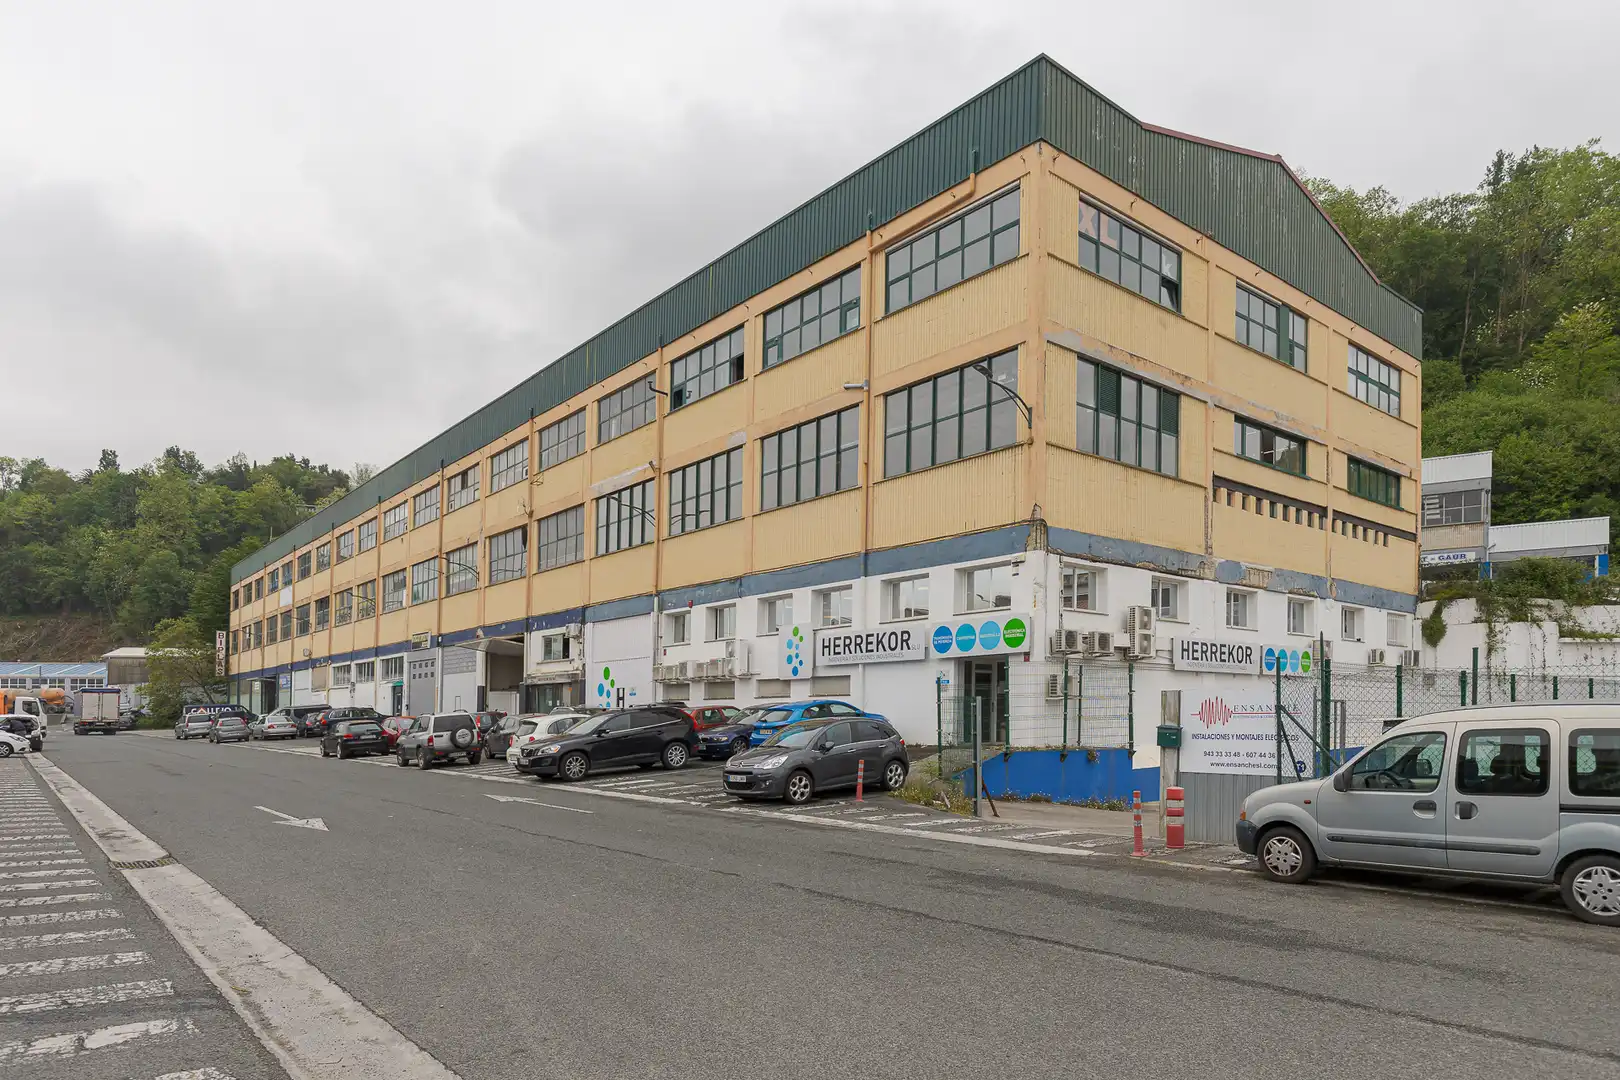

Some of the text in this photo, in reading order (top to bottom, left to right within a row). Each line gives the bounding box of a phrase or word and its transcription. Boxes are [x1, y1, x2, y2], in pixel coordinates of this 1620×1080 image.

[217, 632, 225, 675] BIPLAS
[822, 630, 911, 657] HERREKOR
[1180, 640, 1253, 664] HERREKOR
[1235, 733, 1264, 741] MONTAJES
